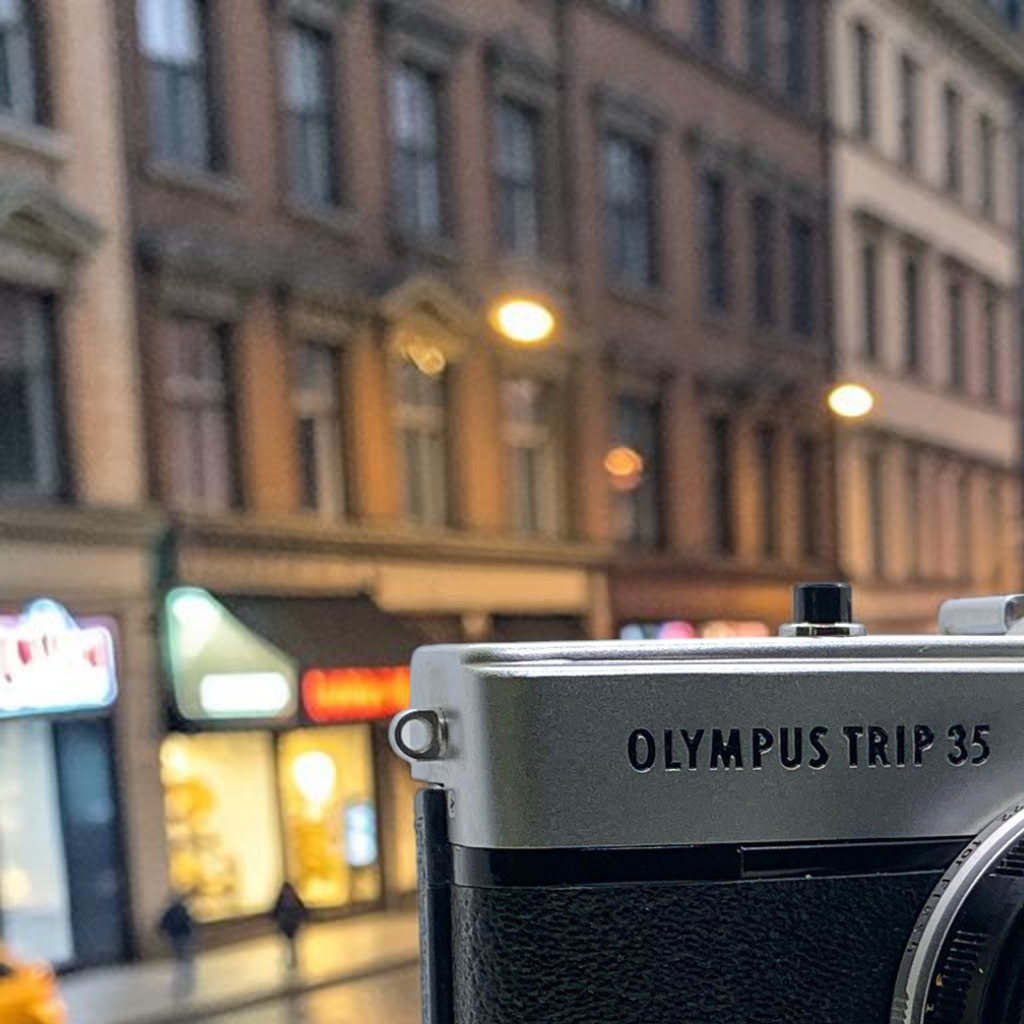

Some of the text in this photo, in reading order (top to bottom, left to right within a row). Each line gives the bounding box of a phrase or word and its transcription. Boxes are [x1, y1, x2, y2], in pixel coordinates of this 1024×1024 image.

[628, 723, 991, 772] OLYMPUS TRIP 35
